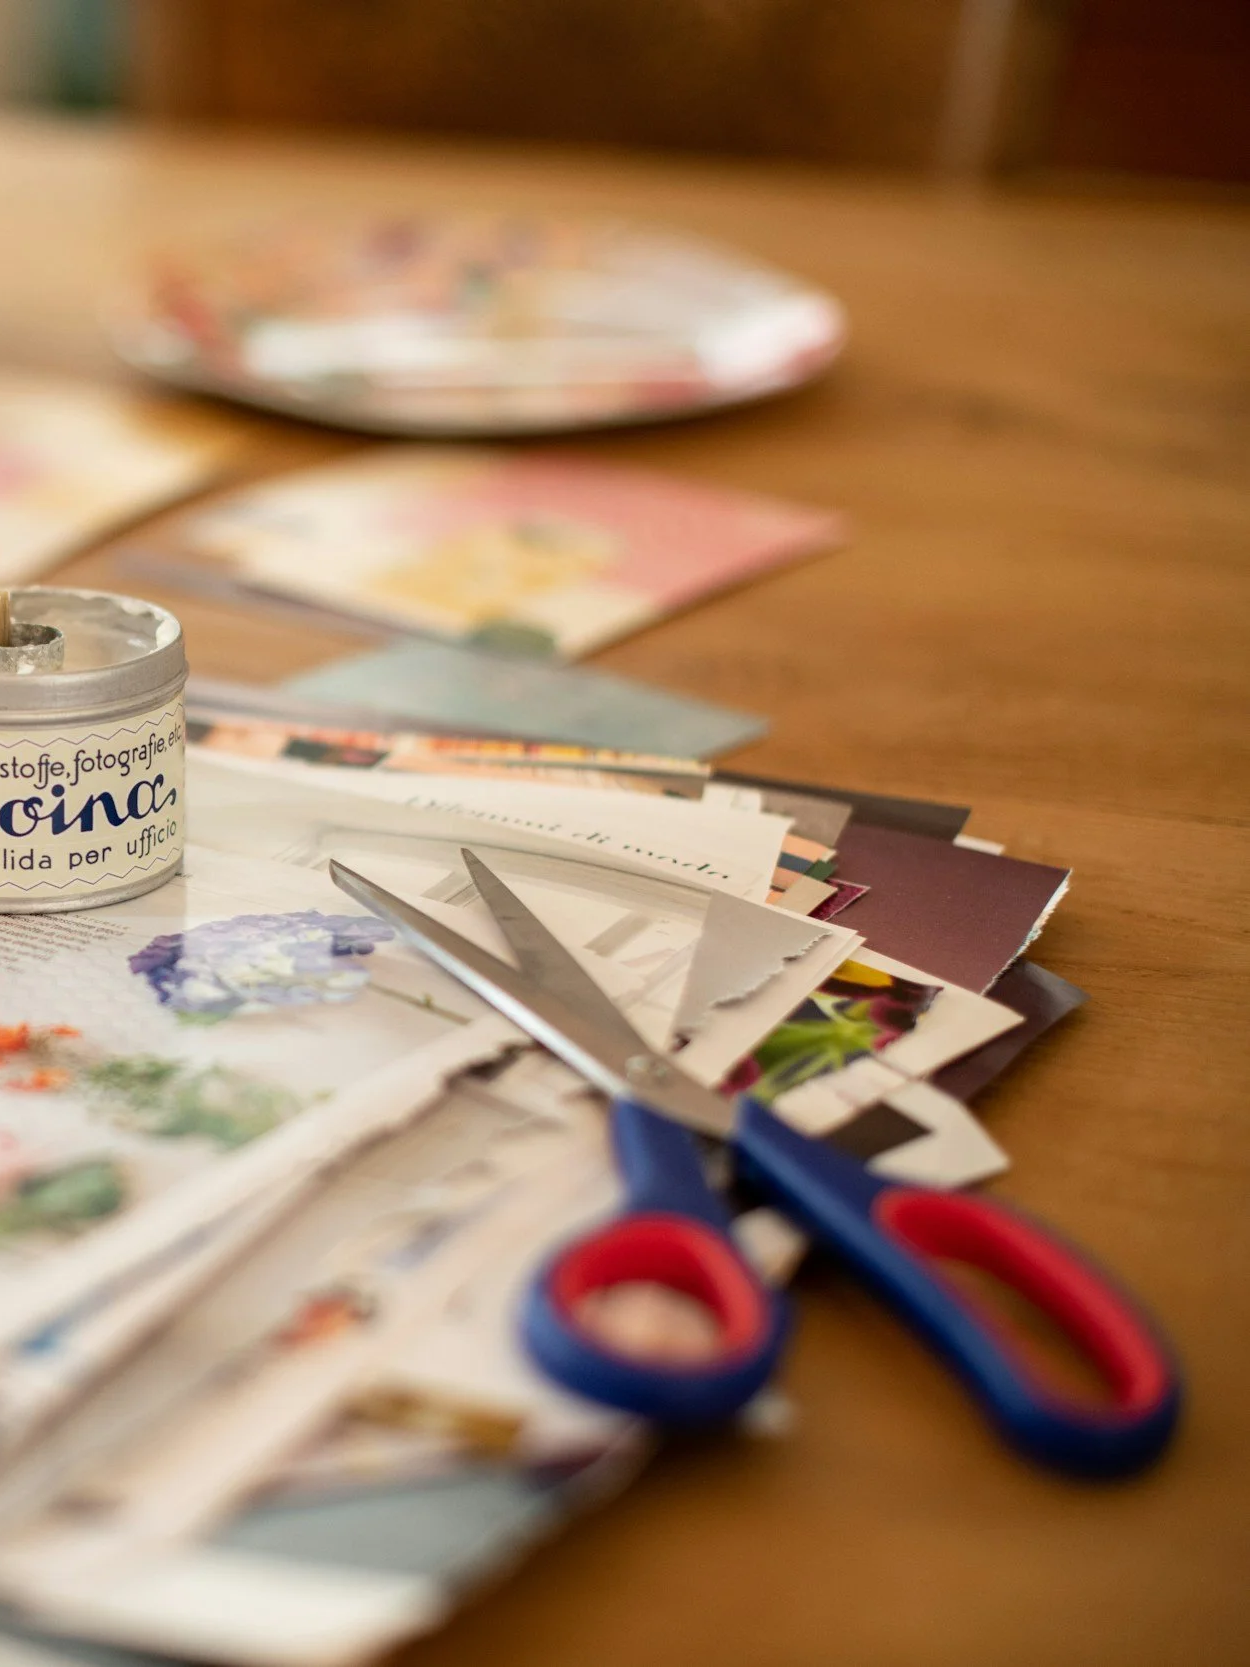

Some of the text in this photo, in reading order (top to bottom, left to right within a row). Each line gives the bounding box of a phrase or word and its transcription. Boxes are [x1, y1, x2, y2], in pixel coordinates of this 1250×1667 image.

[0, 754, 71, 789] stoffe,
[70, 733, 168, 786] fotografie,
[69, 846, 112, 870] per
[127, 818, 177, 857] ufficio
[571, 830, 611, 847] di
